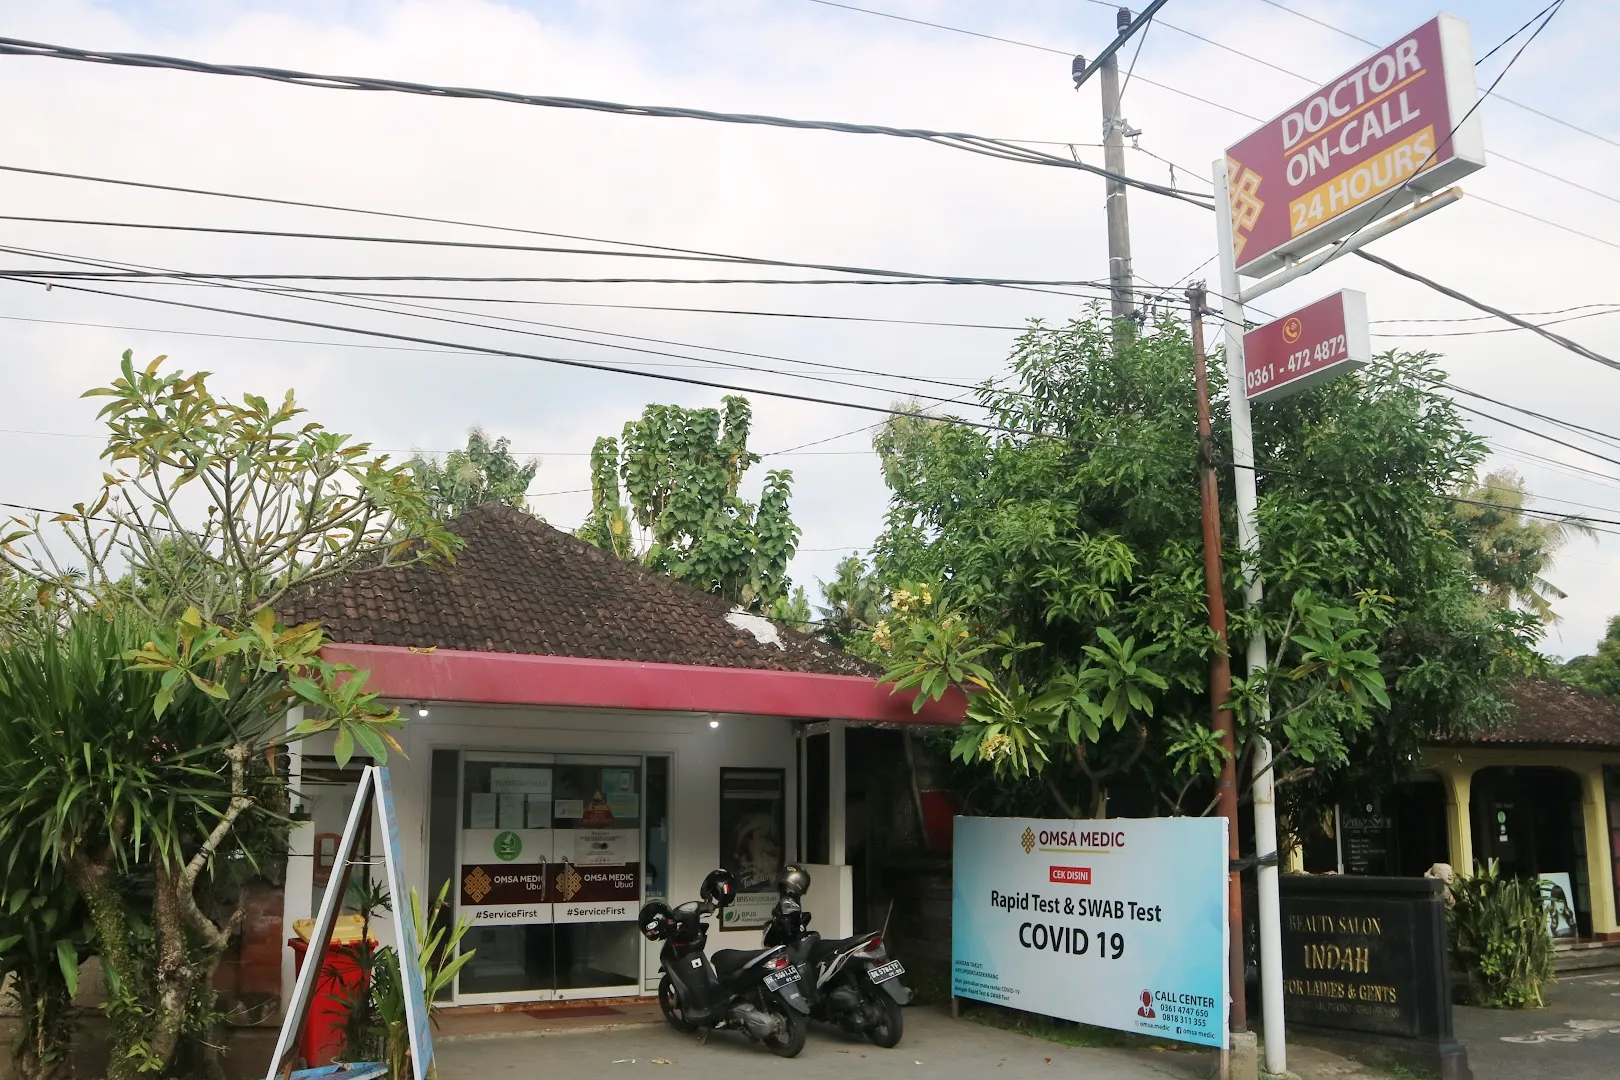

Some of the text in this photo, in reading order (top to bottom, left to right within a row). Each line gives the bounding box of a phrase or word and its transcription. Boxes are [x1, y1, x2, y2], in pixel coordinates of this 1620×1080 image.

[1281, 38, 1421, 151] DOCTOR
[1286, 91, 1420, 187] ON-CALL
[1292, 132, 1434, 234] 24 HOURS
[1247, 364, 1275, 390] 0361
[1287, 346, 1311, 373] 472
[1313, 334, 1346, 363] 4872
[1039, 831, 1125, 848] OMSA MEDIC
[494, 875, 519, 884] OMSA
[584, 873, 634, 882] OMSA MEDIC
[1053, 869, 1088, 881] CEK DISINI
[526, 882, 542, 891] Ubu
[615, 880, 634, 889] Ubud
[566, 906, 626, 918] #ServiceFirst
[991, 890, 1162, 923] Rapid Test & SWAB Test
[475, 909, 538, 920] #ServiceFirst
[1290, 915, 1382, 935] BEAUTY SALON
[1019, 922, 1125, 960] COVID 19
[1304, 943, 1369, 974] INDAH
[968, 987, 978, 995] Rapid
[990, 992, 1001, 1000] SWAB
[1001, 986, 1020, 995] COVID-19
[1306, 981, 1344, 998] LADIES
[1348, 983, 1357, 999] &
[1359, 985, 1397, 1003] GENTS
[1155, 990, 1215, 1008] CALL CENTER
[1161, 1004, 1209, 1017] 0361 4747 650
[1140, 1021, 1170, 1031] omsa.medic
[1163, 1013, 1206, 1027] 0818 311 355
[1183, 1028, 1215, 1039] omsa medic
